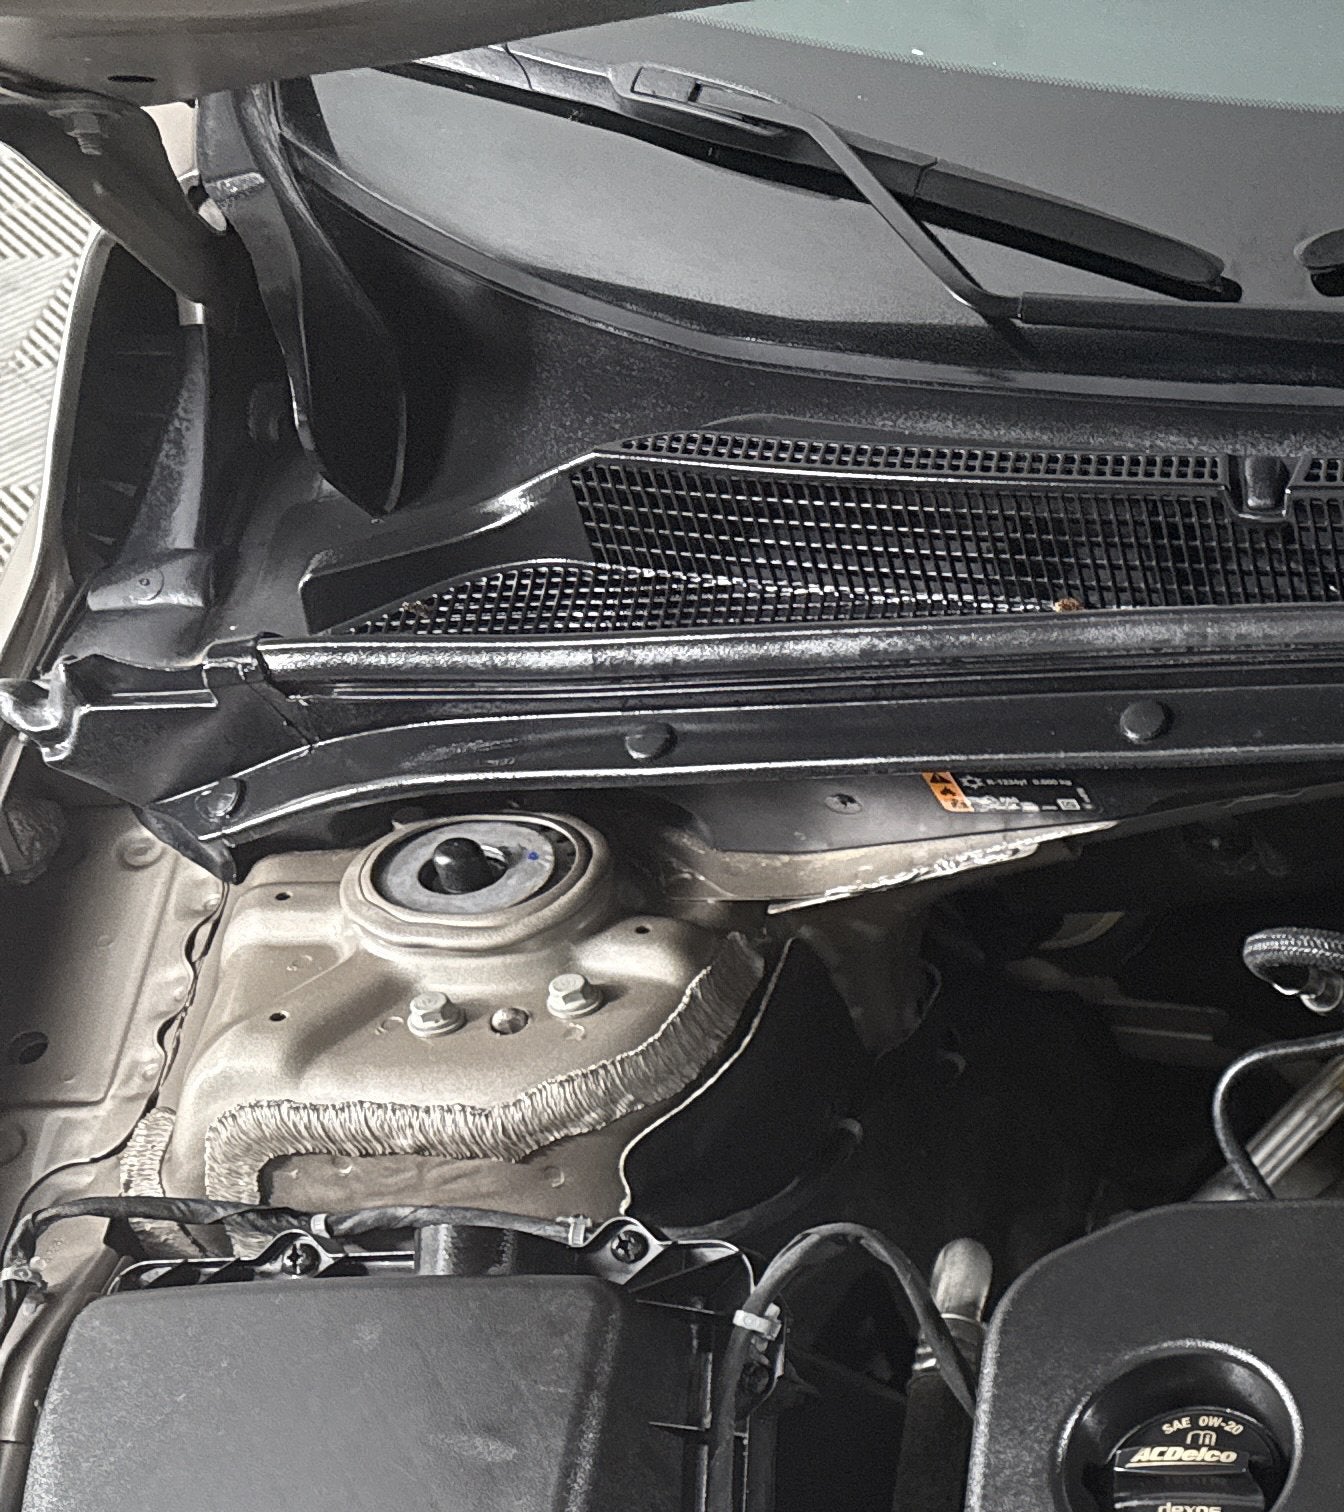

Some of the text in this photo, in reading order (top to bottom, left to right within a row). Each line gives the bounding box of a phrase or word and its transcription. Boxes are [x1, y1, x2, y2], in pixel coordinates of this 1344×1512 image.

[1162, 1415, 1244, 1436] SAE 0W-20
[1130, 1446, 1238, 1463] ACDelco
